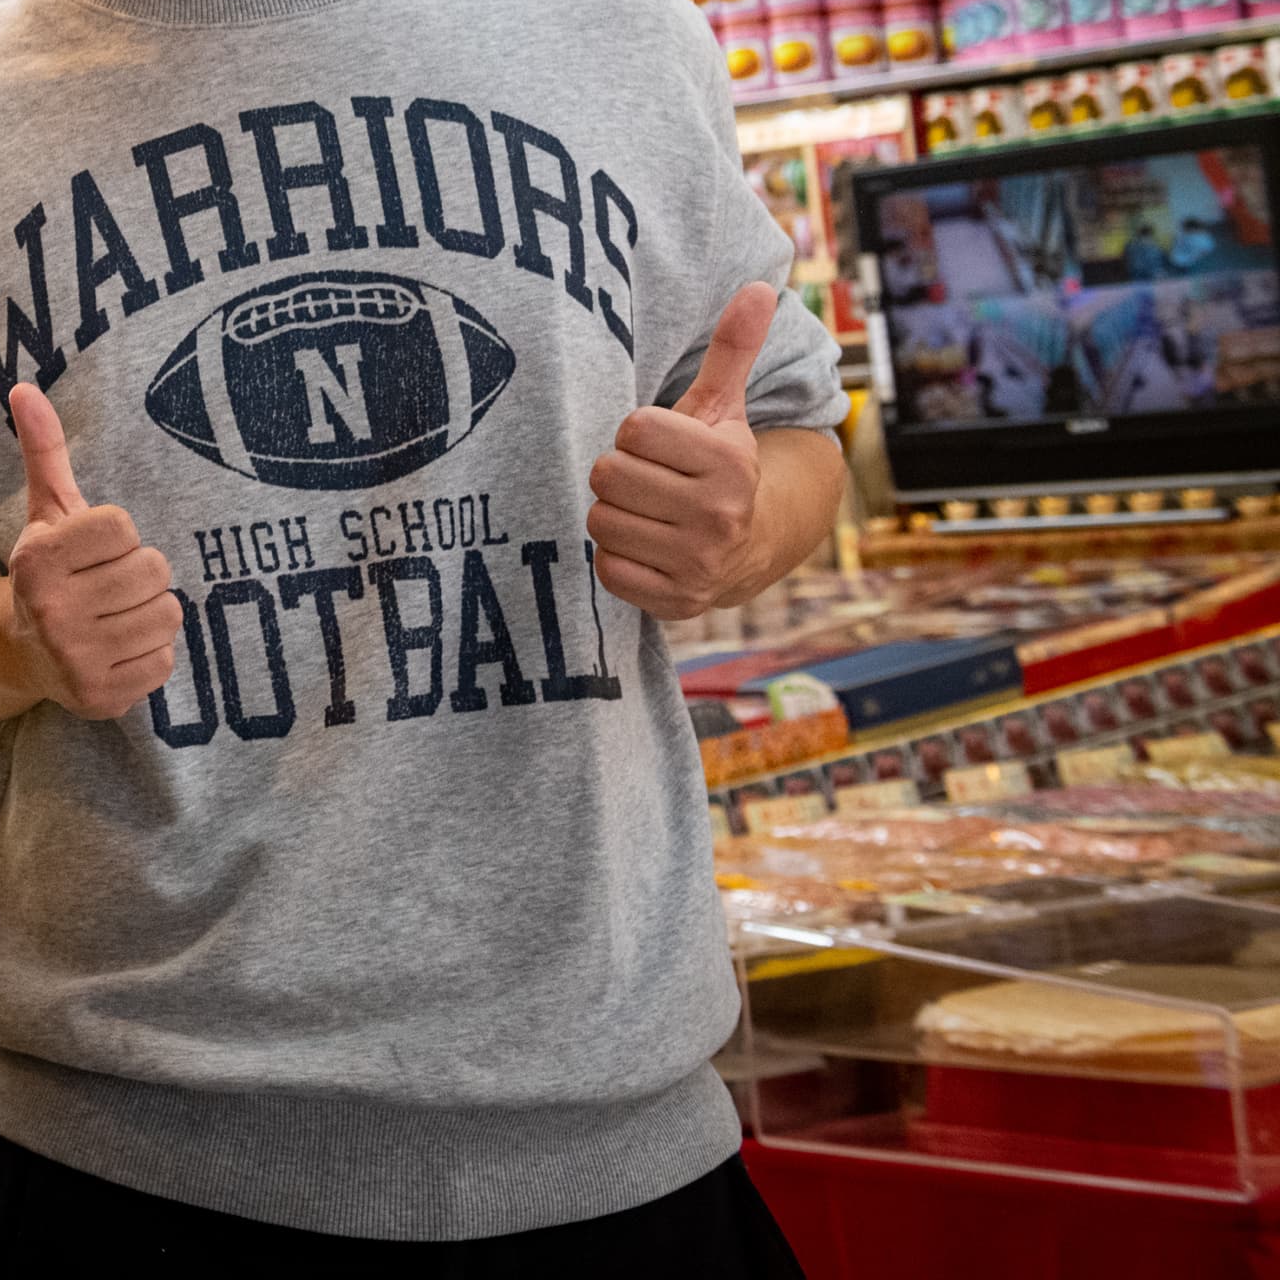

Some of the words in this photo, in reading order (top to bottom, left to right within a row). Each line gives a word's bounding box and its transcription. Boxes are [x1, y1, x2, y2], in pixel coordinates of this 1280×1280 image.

[293, 341, 372, 446] N
[194, 516, 316, 582] HIGH
[338, 493, 511, 563] SCHOOL
[148, 538, 622, 749] OOTBAL
